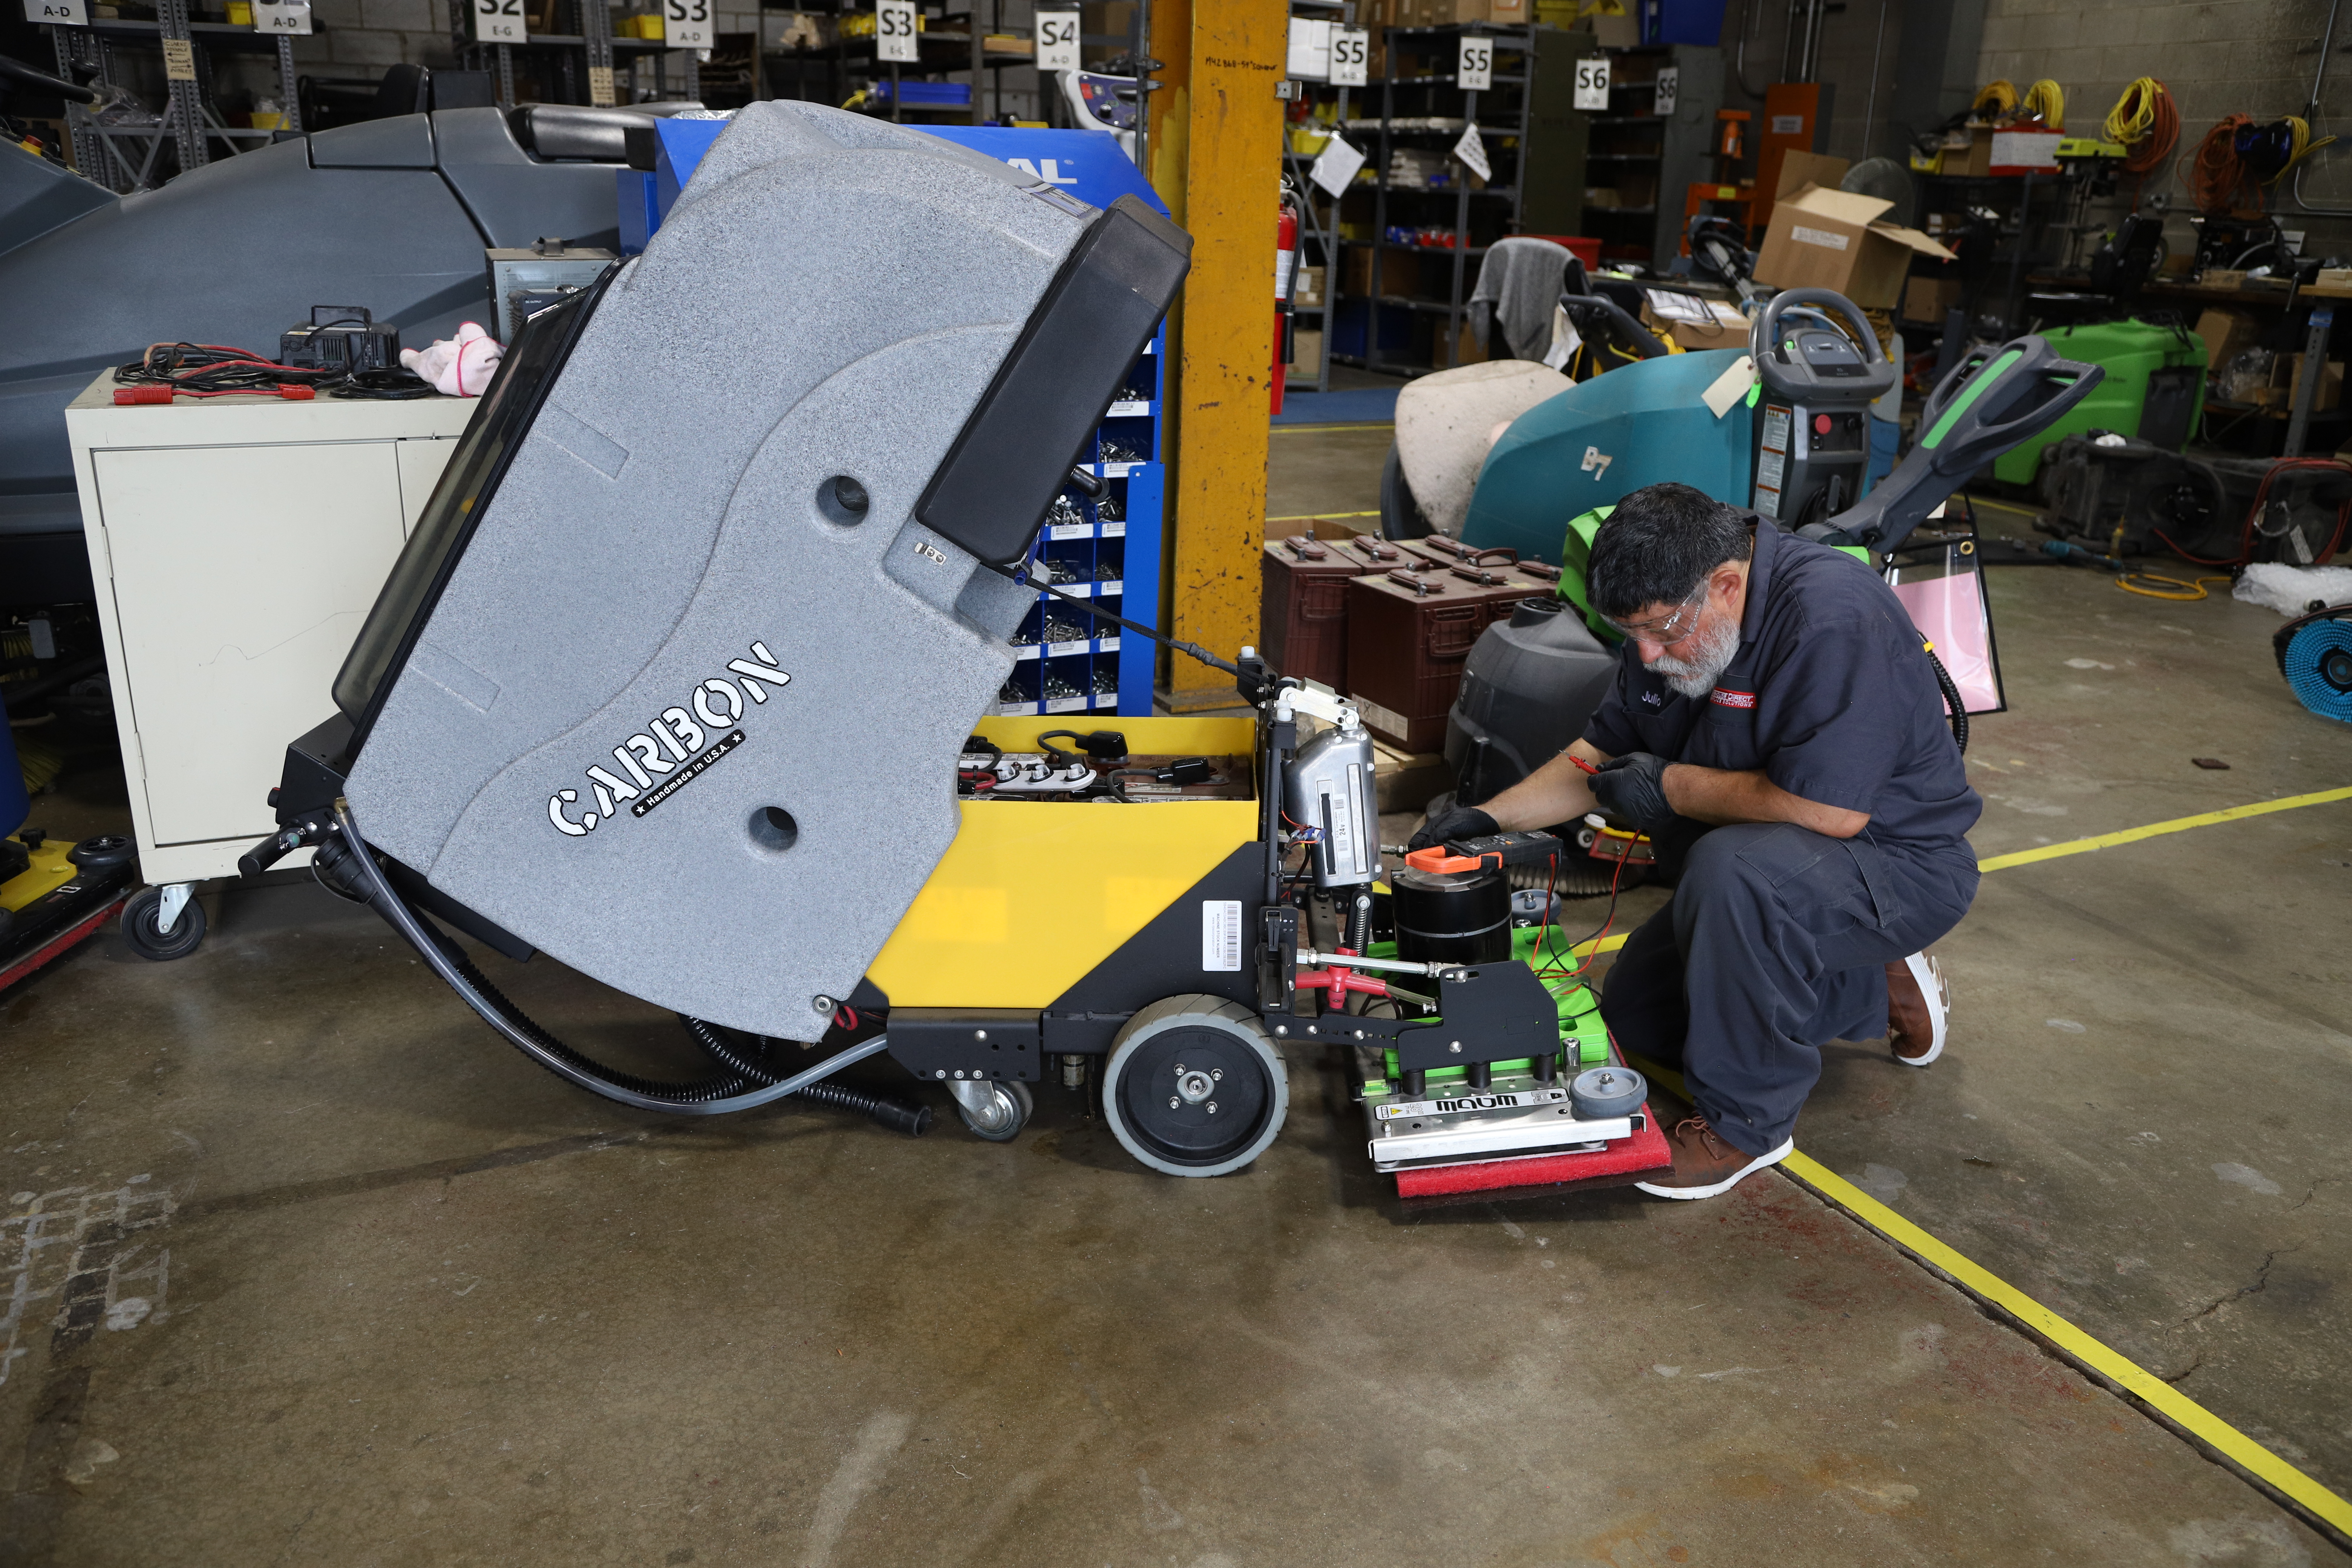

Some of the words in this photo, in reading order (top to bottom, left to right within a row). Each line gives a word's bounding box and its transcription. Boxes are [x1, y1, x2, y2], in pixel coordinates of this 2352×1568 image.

[44, 6, 70, 17] A-D
[669, 0, 707, 22] S3
[274, 18, 297, 28] A-D
[493, 26, 512, 36] E-G
[881, 9, 911, 37] S3
[1042, 21, 1076, 46] S4
[680, 32, 701, 41] A-D
[1050, 55, 1069, 64] A-D
[1335, 40, 1363, 63] S5
[1463, 48, 1488, 71] S5
[1579, 67, 1606, 89] S6
[1658, 77, 1675, 99] S6
[1642, 691, 1661, 707] Julio
[1728, 693, 1751, 702] DIRECT
[548, 640, 791, 836] CARBON
[646, 769, 693, 807] Handmade
[692, 760, 704, 773] in
[704, 744, 730, 764] U.S.A.
